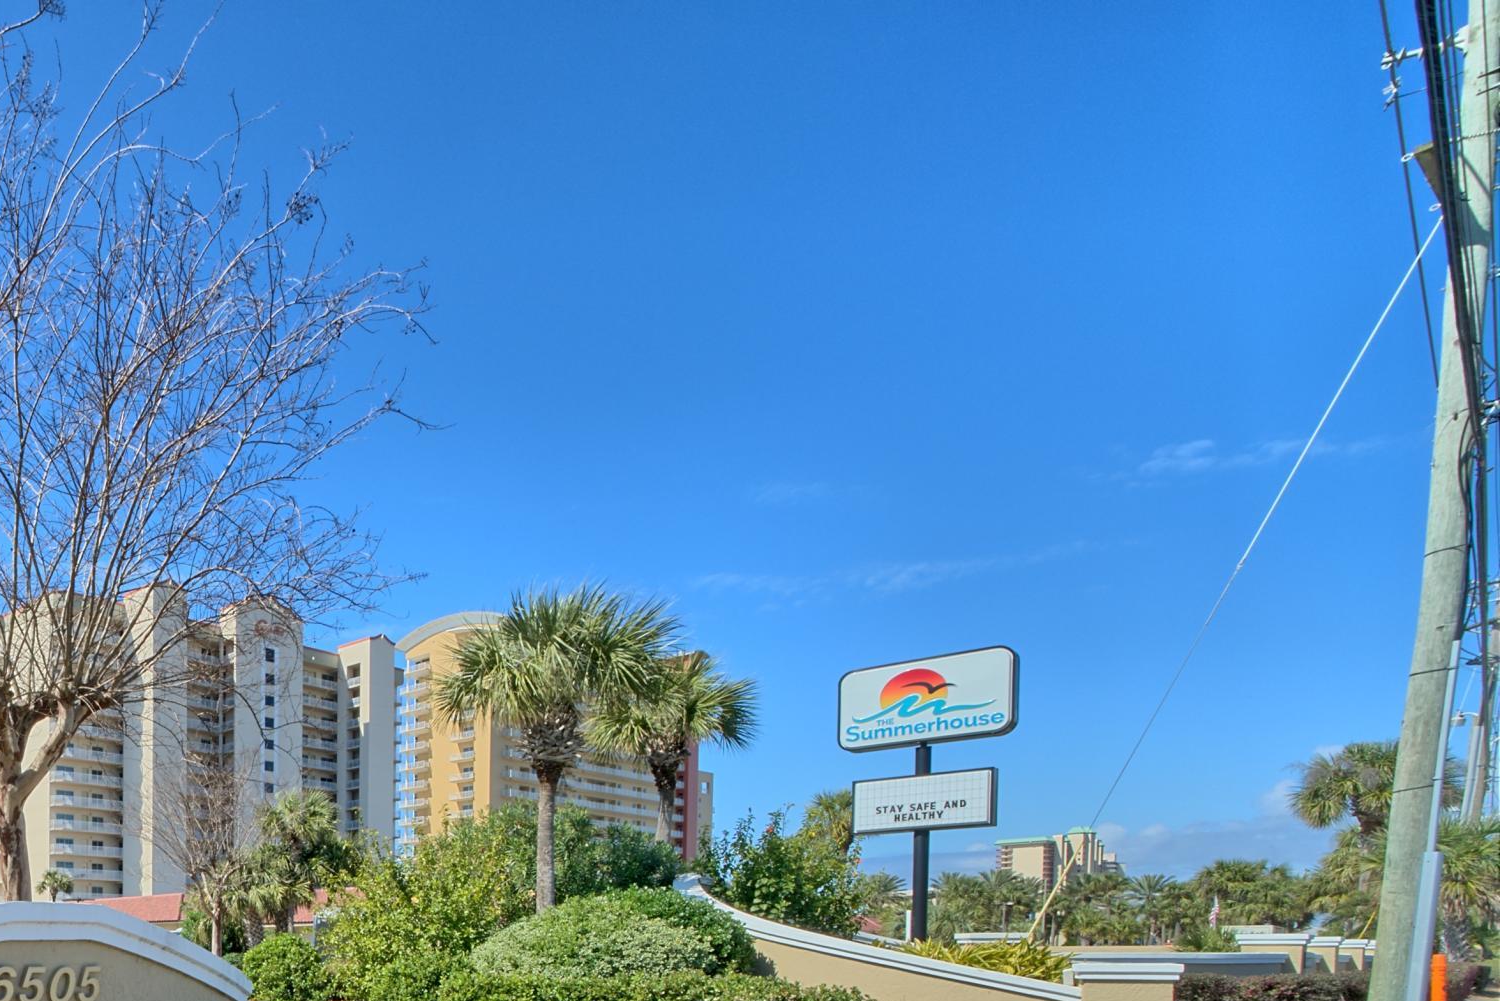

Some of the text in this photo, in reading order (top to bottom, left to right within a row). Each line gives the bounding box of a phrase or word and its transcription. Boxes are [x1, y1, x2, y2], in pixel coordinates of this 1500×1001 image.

[845, 711, 1004, 742] Summerhouse
[876, 717, 895, 726] THE
[875, 799, 967, 814] STAY SAFE AND
[894, 811, 944, 822] HEALTHY
